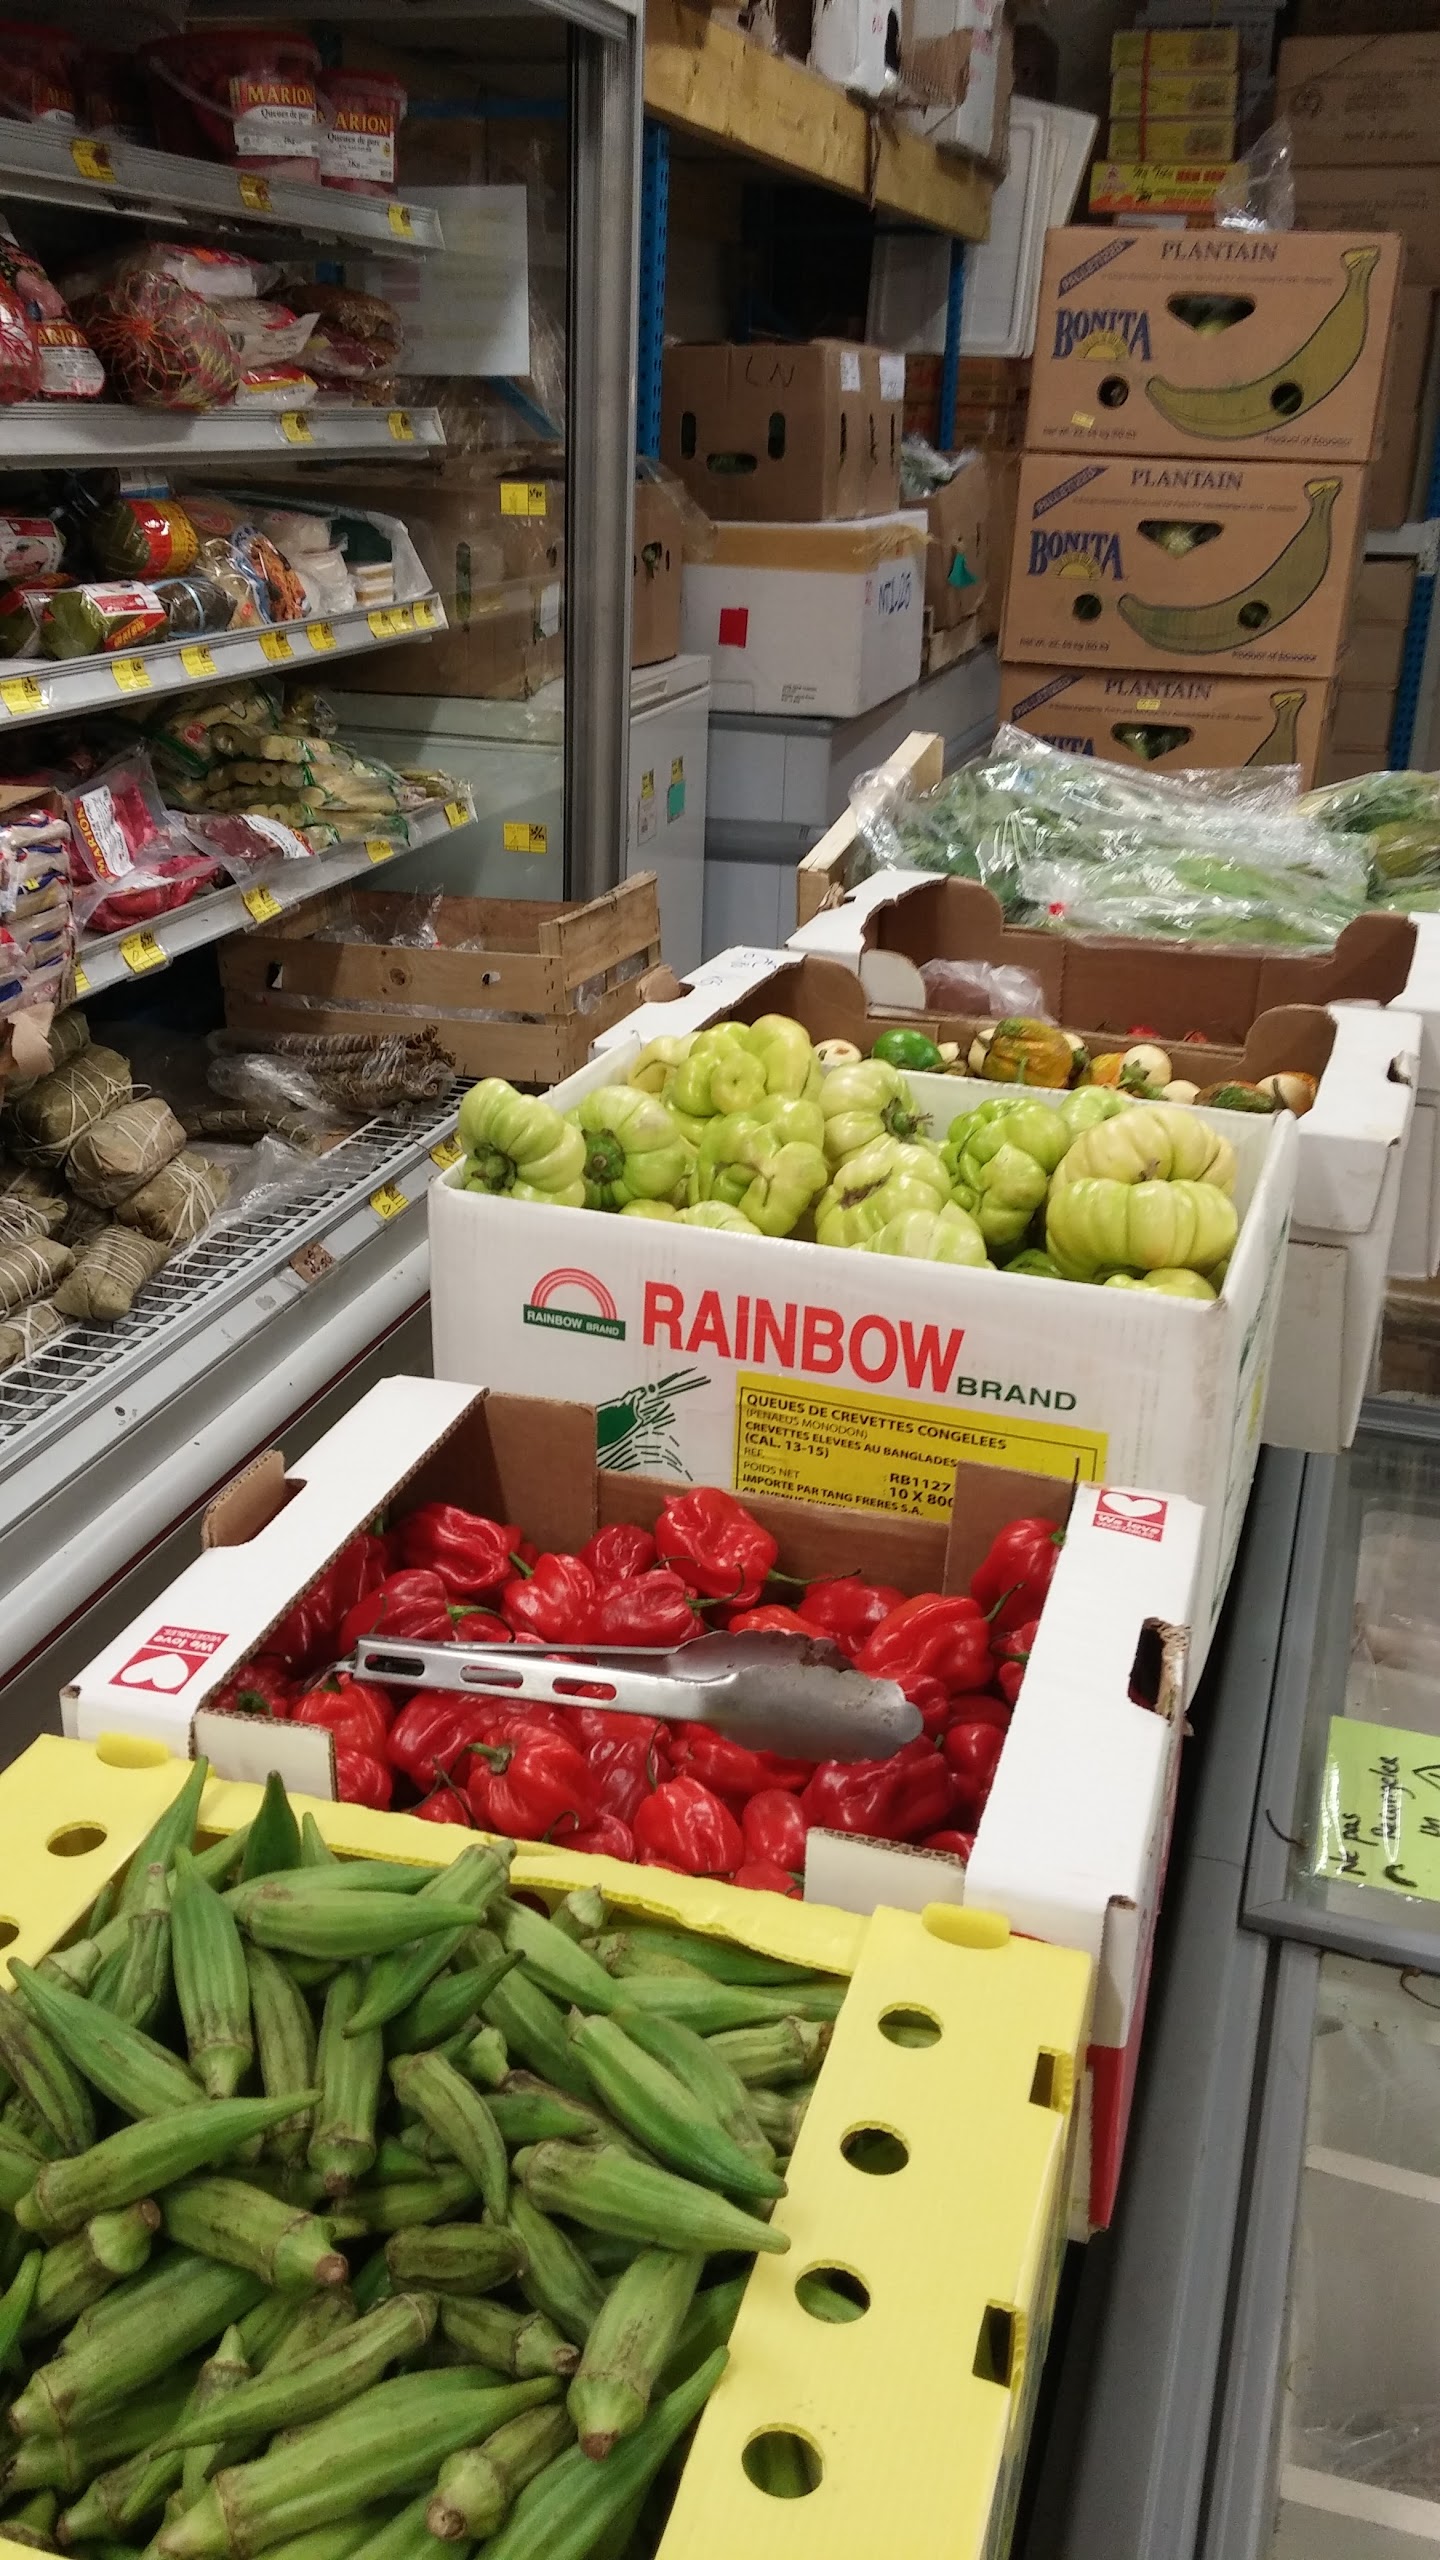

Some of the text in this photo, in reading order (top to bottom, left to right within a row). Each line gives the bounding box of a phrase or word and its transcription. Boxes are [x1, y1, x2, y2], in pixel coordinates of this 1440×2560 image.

[248, 85, 316, 104] MARION
[1161, 239, 1279, 263] PLANTAIN
[37, 327, 89, 345] ARION
[1052, 308, 1151, 361] BONITA
[1130, 468, 1243, 491] PLANTAIN
[1028, 529, 1124, 581] BONITA
[1105, 678, 1215, 701] PLANTAIN
[75, 806, 106, 874] MARION
[526, 1310, 620, 1336] RAINBOW BRAND
[643, 1281, 1077, 1411] RAINBOW BRAND
[746, 1409, 868, 1440] (PENAEUS MONODON)
[747, 1394, 1007, 1450] QUEUES DE CREVETTES CONGELEES
[745, 1421, 957, 1468] CREVETTES ELEVEES AU BANGLADES
[745, 1432, 829, 1459] (CAL. 13-15)
[743, 1460, 776, 1475] POIDS
[779, 1467, 800, 1479] NET
[890, 1486, 908, 1499] 10
[912, 1491, 922, 1503] X
[743, 1473, 794, 1491] IMPORTE
[797, 1483, 819, 1496] PAR
[821, 1488, 852, 1502] TANG
[855, 1495, 898, 1512] FRERES
[901, 1503, 924, 1516] S.A.
[1097, 1514, 1161, 1535] We love
[153, 1634, 216, 1653] We love
